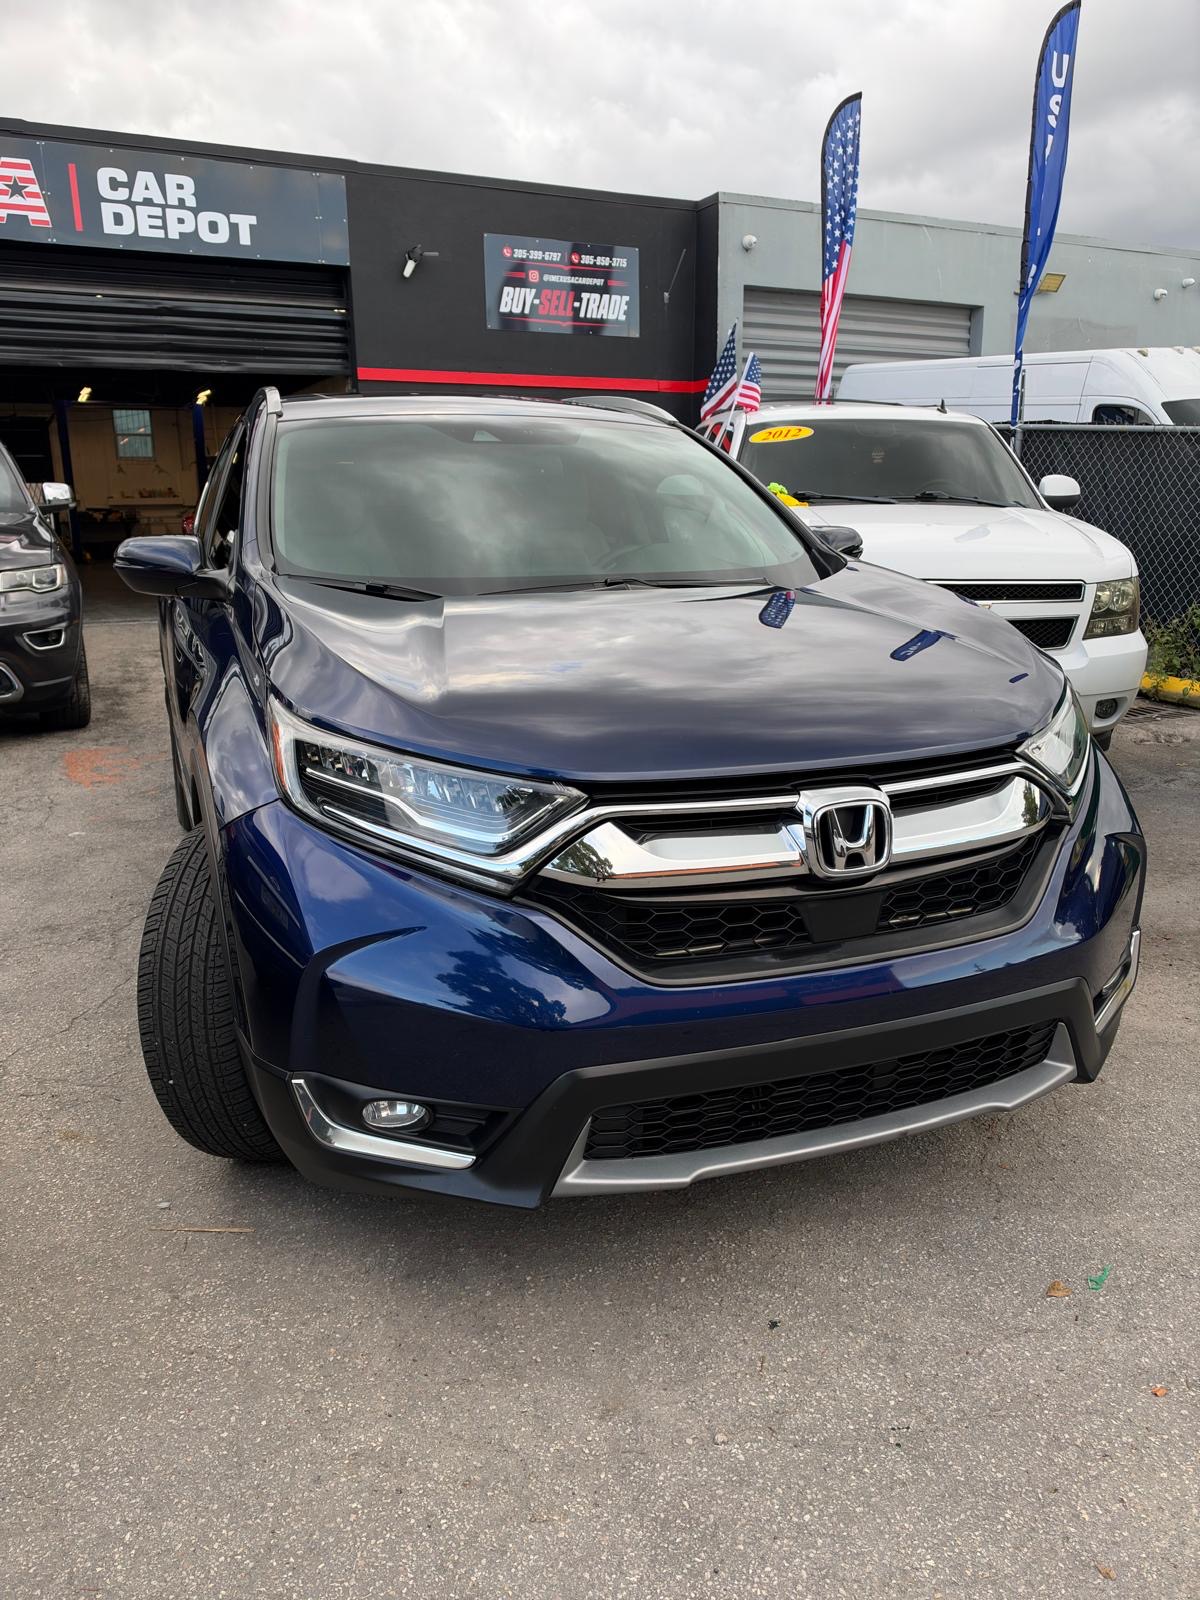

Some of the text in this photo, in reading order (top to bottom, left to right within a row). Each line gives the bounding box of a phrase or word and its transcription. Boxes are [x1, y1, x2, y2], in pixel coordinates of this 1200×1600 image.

[97, 167, 197, 207] CAR
[101, 202, 257, 245] DEPOT
[513, 249, 561, 262] 305-399-6797
[762, 428, 802, 440] 2012
